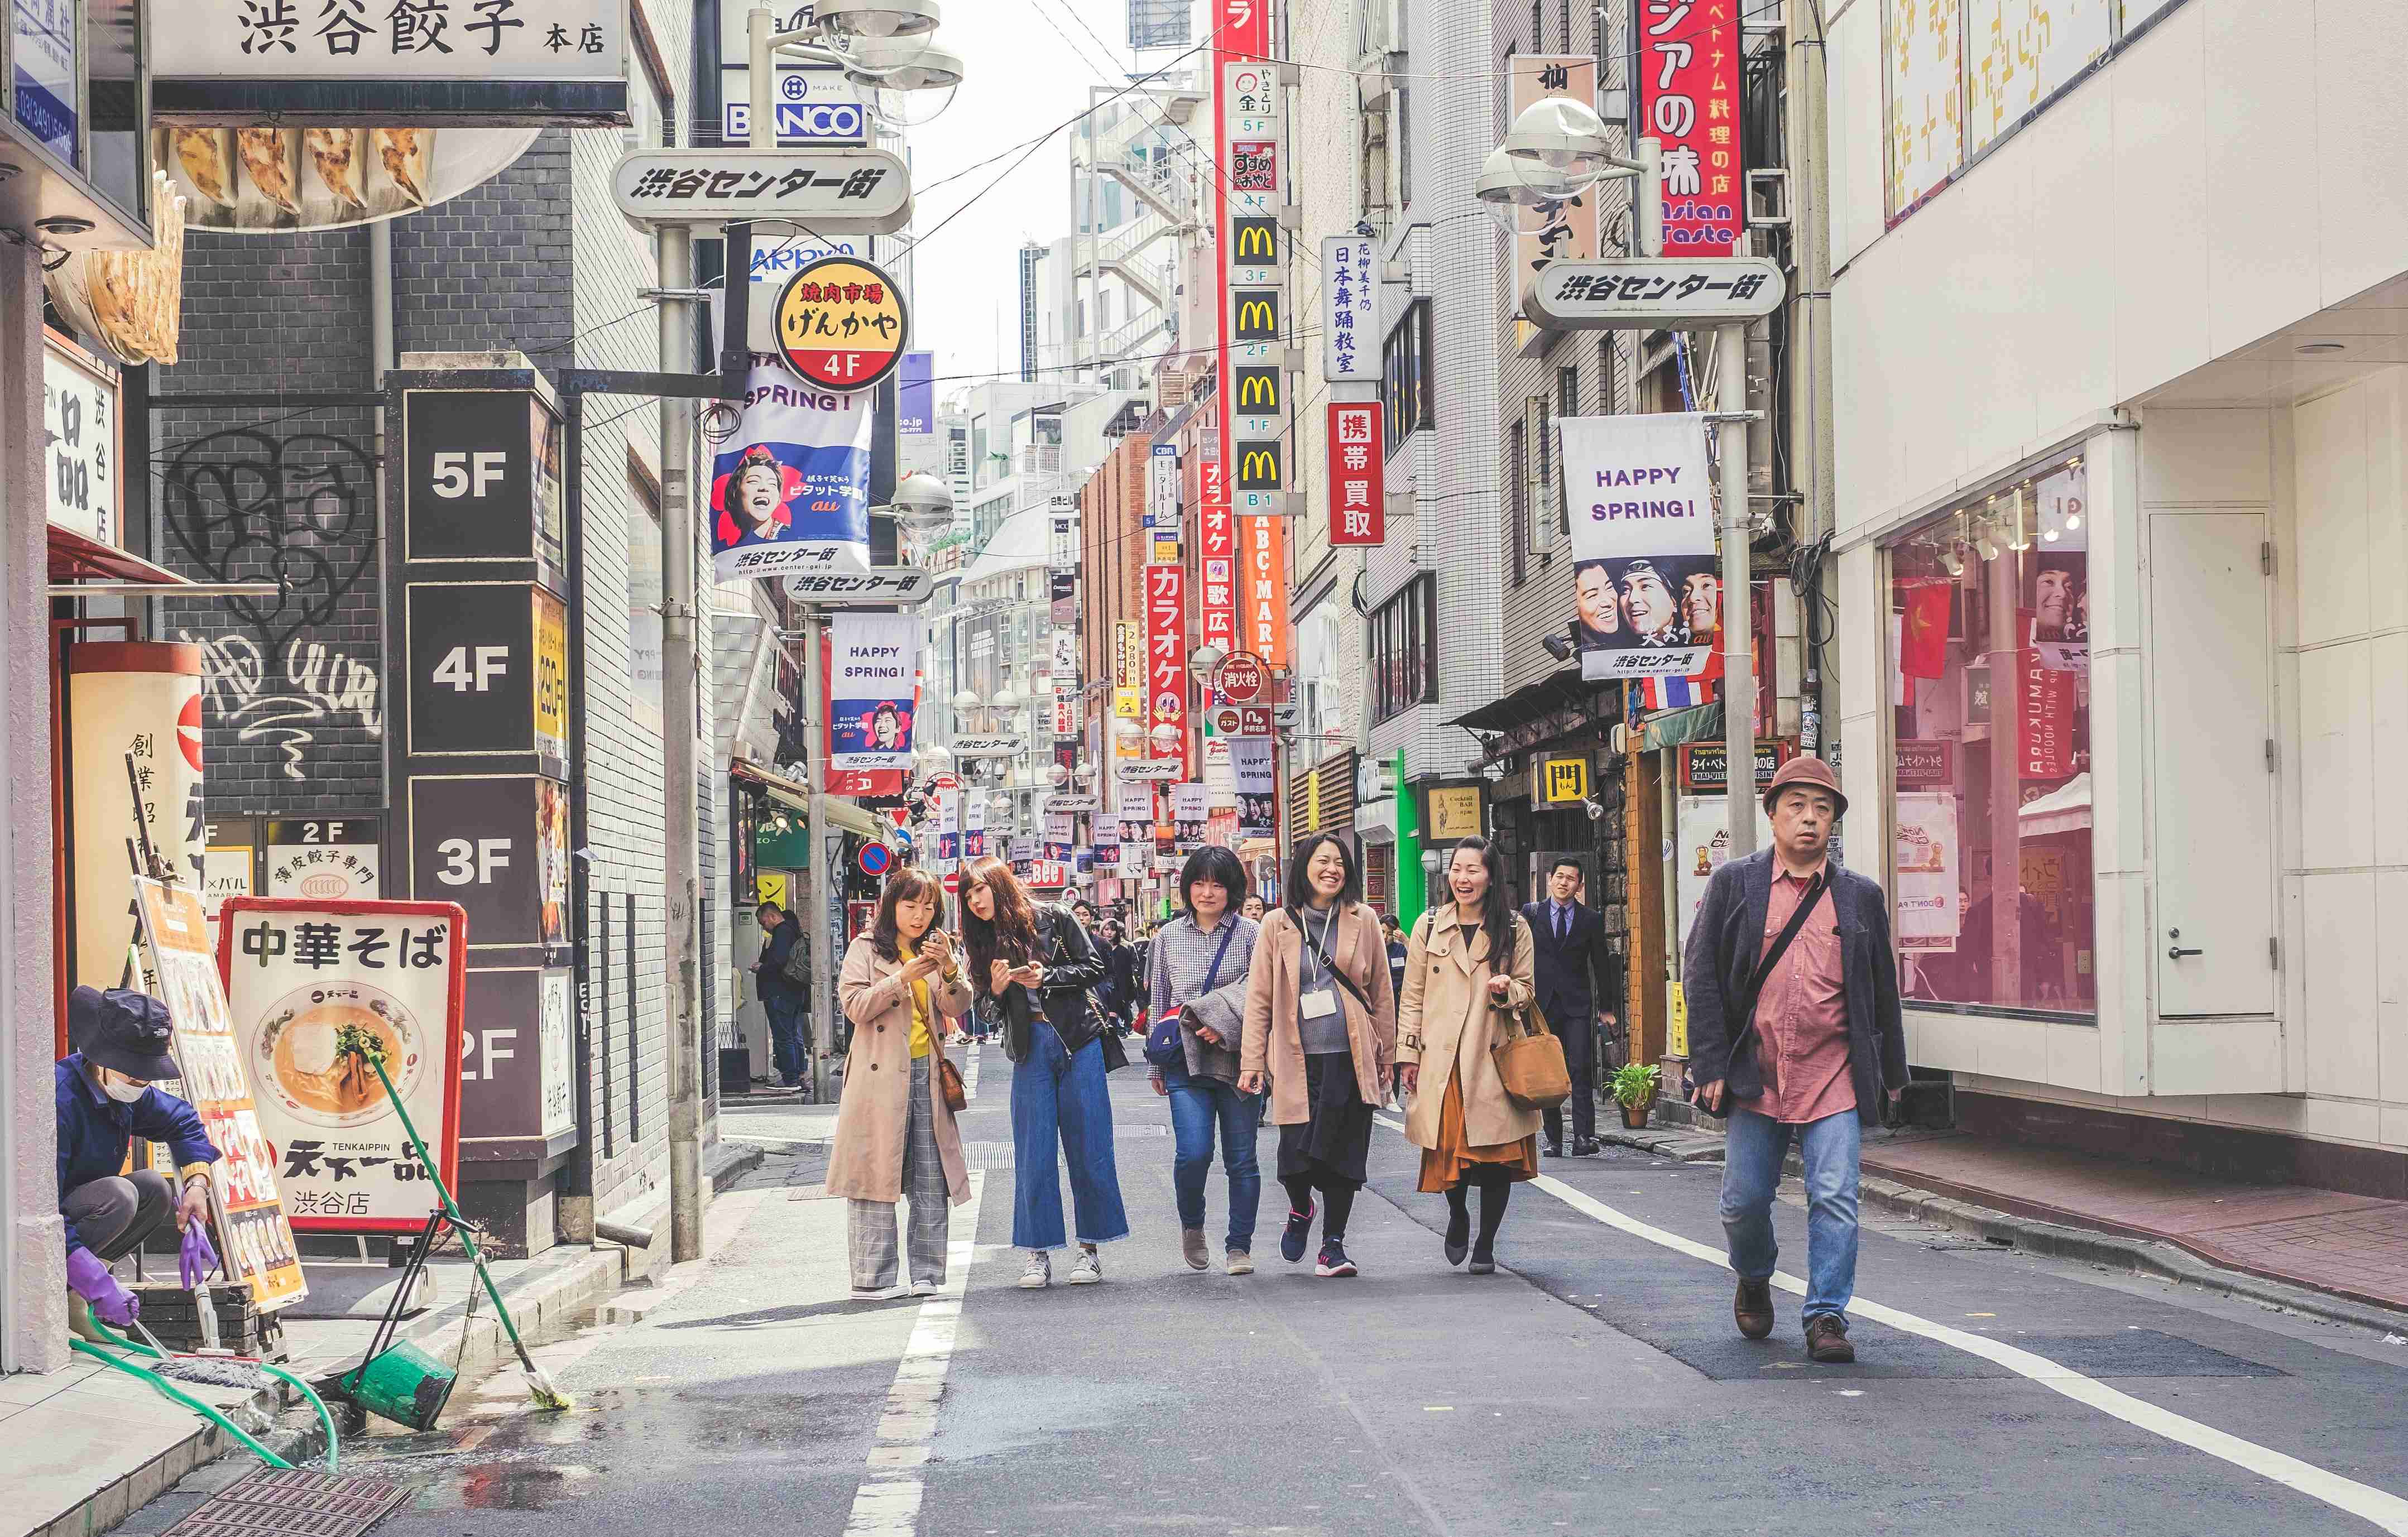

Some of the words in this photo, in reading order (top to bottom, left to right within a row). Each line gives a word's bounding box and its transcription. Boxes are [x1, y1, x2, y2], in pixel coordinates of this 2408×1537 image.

[238, 0, 526, 55] 渋谷餃子
[544, 23, 605, 54] 本店
[1239, 95, 1256, 111] 金
[1708, 4, 1732, 195] ベトナム料理の店
[729, 105, 860, 136] BNCO
[1243, 120, 1264, 132] 5F
[630, 167, 886, 199] 渋谷センター街
[1244, 196, 1266, 206] 4F
[1245, 271, 1267, 282] 3F
[1555, 274, 1767, 300] 渋谷センター街
[800, 283, 883, 305] 焼肉市場
[1333, 247, 1356, 373] 日本舞踊教室
[788, 307, 898, 340] げんかや
[1247, 344, 1268, 356] 2F
[824, 353, 860, 377] 4F
[743, 384, 850, 411] SPRING!
[1249, 420, 1269, 431] 1F
[95, 387, 106, 542] 渋谷店
[432, 452, 506, 498] 5F
[1342, 414, 1371, 537] 携帯買取
[1596, 467, 1681, 487] HAPPY
[811, 501, 840, 512] au
[1206, 464, 1227, 552] カラオケ
[1248, 493, 1272, 506] B1
[1591, 500, 1695, 521] SPRING!
[735, 547, 838, 568] 渋谷センター街
[793, 576, 921, 592] 渋谷センター街
[1152, 567, 1183, 689] カラオケ
[1693, 634, 1711, 644] au
[850, 647, 900, 657] HAPPY
[1117, 625, 1126, 686] 全身もみほぐし
[1613, 652, 1695, 668] 渋谷センター街
[433, 646, 509, 691] 4F
[845, 667, 905, 677] SPRING!
[1224, 671, 1258, 688] 消火栓
[954, 739, 1020, 748] 渋谷センター街
[846, 756, 896, 764] 渋谷センター街
[1120, 765, 1179, 774] 渋谷センター街
[1551, 764, 1581, 797] 門
[303, 823, 343, 843] 2F
[274, 850, 375, 885] 薄皮餃子専門
[436, 838, 511, 885] 3F
[242, 920, 447, 970] 中華そば
[332, 1142, 390, 1152] TENKAIPPIN
[283, 1140, 438, 1182] 天下一品
[294, 1191, 371, 1214] 渋谷店
